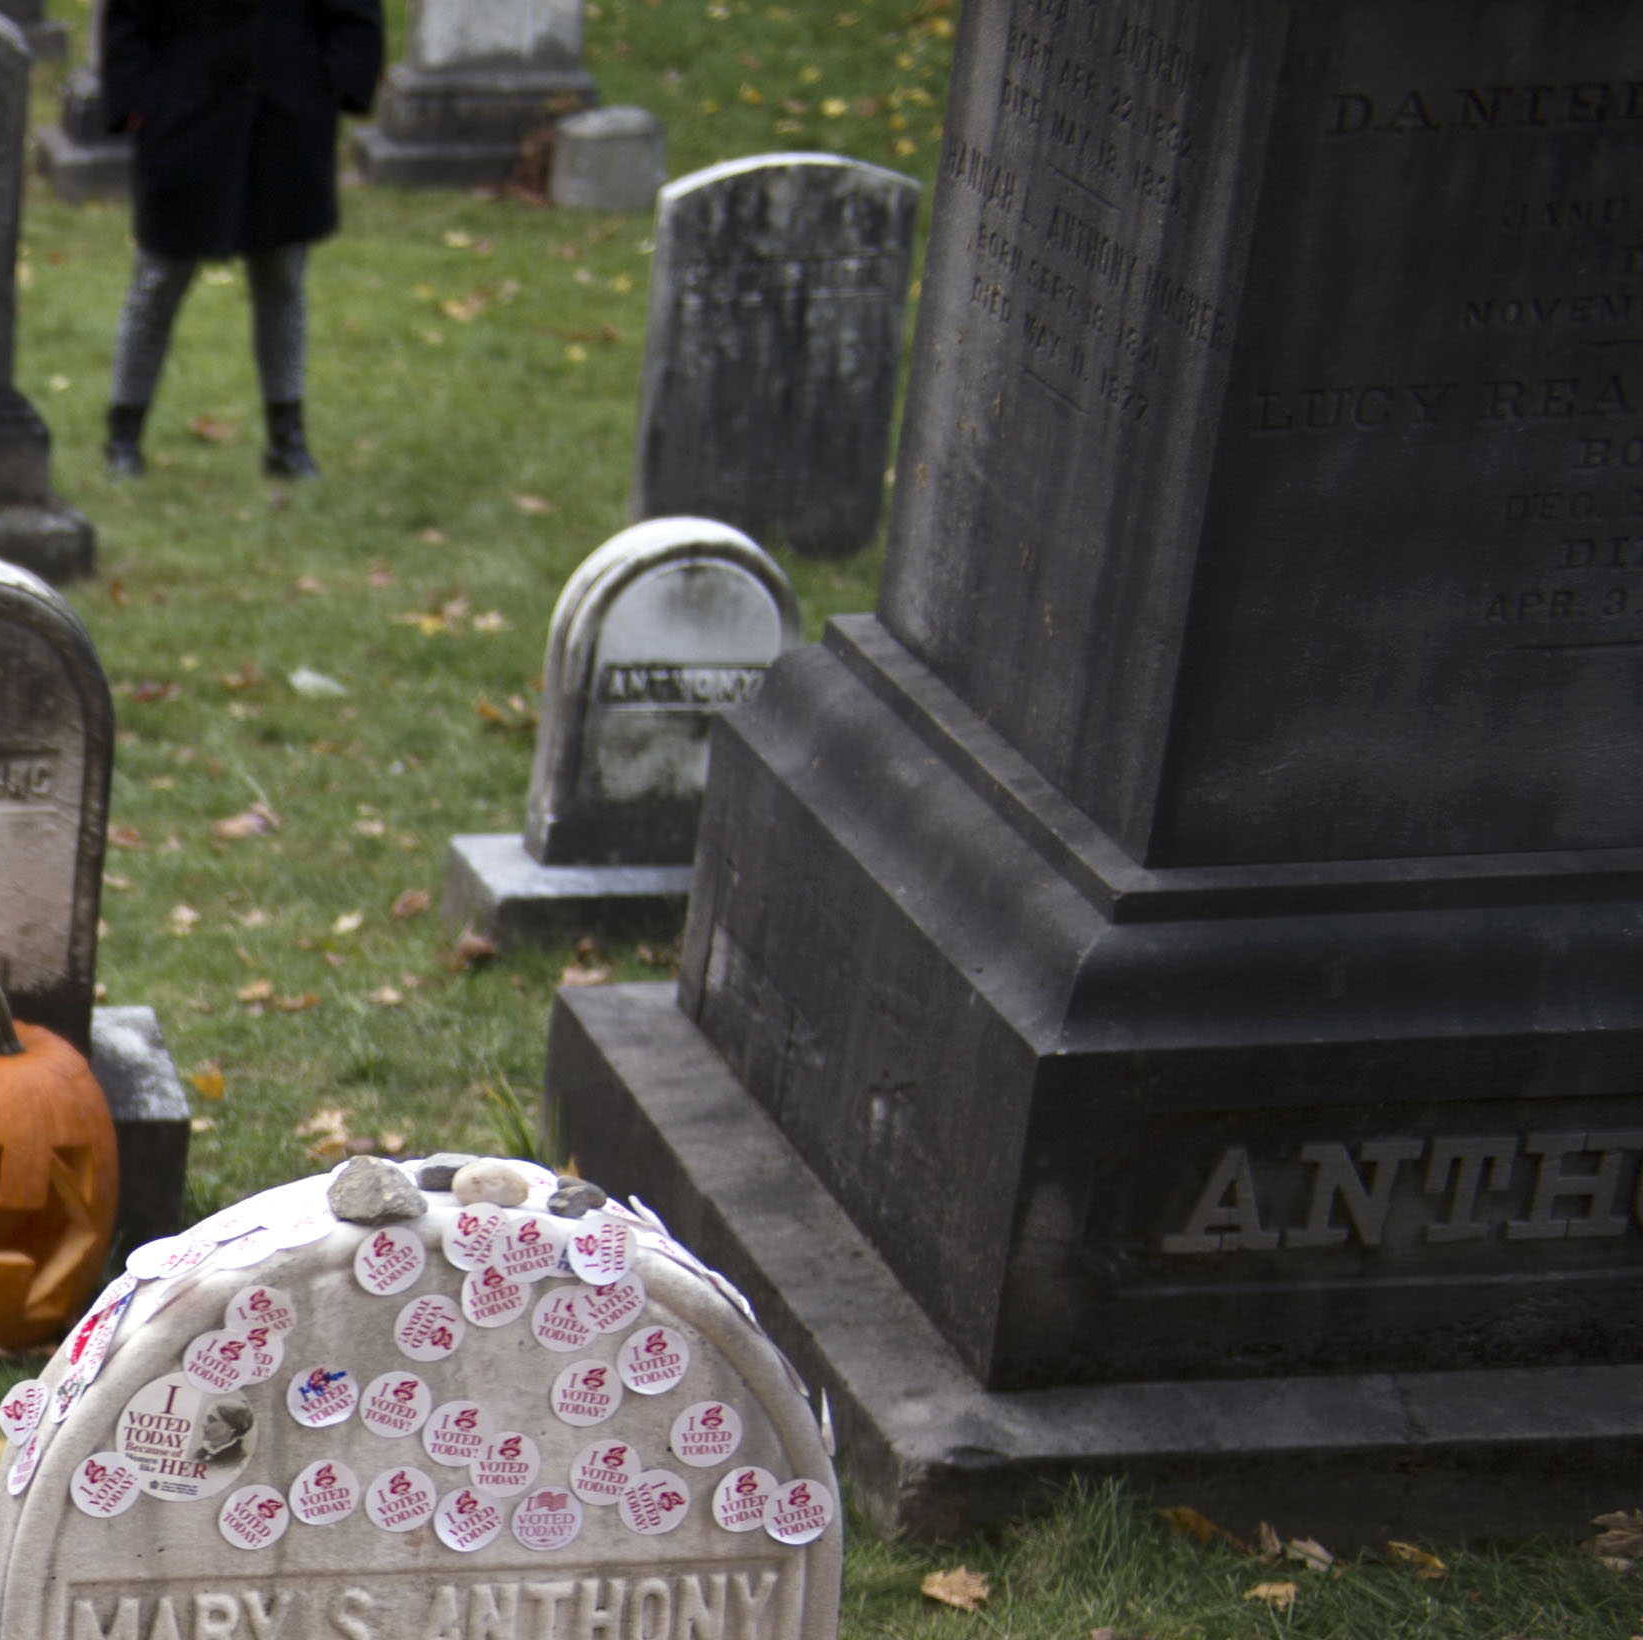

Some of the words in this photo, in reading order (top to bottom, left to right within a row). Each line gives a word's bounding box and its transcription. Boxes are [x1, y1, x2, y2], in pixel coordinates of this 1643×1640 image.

[1251, 384, 1462, 434] LUCY
[1162, 1131, 1643, 1255] ANTH
[364, 1256, 377, 1270] I
[366, 1245, 414, 1281] VOTED
[373, 1255, 423, 1292] TODAY!
[629, 1353, 681, 1374] VOTED
[633, 1346, 641, 1361] I
[632, 1365, 684, 1387] TODAY!
[160, 1384, 182, 1416] I
[128, 1411, 191, 1434] VOTED
[688, 1416, 696, 1431] I
[123, 1426, 190, 1449] TODAY
[681, 1431, 733, 1444] VOTED
[680, 1444, 732, 1457] TODAY!
[159, 1458, 208, 1481] HER
[525, 1496, 533, 1512] I
[517, 1513, 576, 1526] VOTED
[516, 1526, 573, 1538] TODAY!
